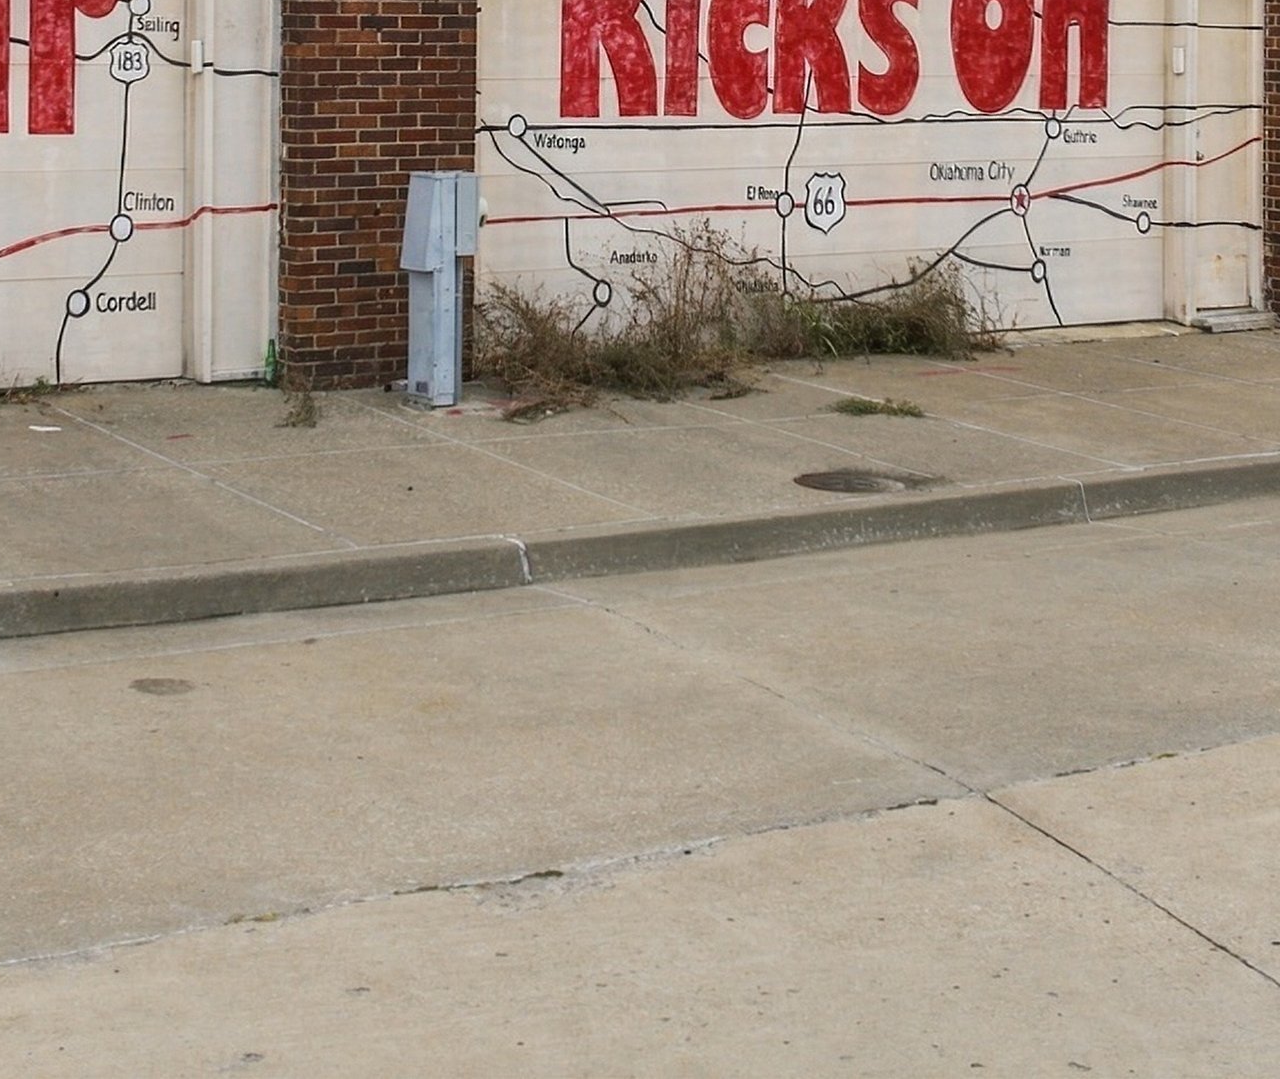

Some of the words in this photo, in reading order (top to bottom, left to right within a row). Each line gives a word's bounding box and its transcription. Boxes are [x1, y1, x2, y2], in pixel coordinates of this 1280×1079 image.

[136, 17, 181, 41] Seiling
[117, 51, 143, 72] 183
[533, 132, 587, 154] Watonga
[1062, 128, 1098, 144] Guthrie
[987, 160, 1016, 185] City
[123, 191, 176, 214] Clinton
[746, 186, 757, 199] El
[813, 185, 836, 216] 66
[1121, 194, 1158, 210] Shawnee
[95, 290, 158, 314] Cordell
